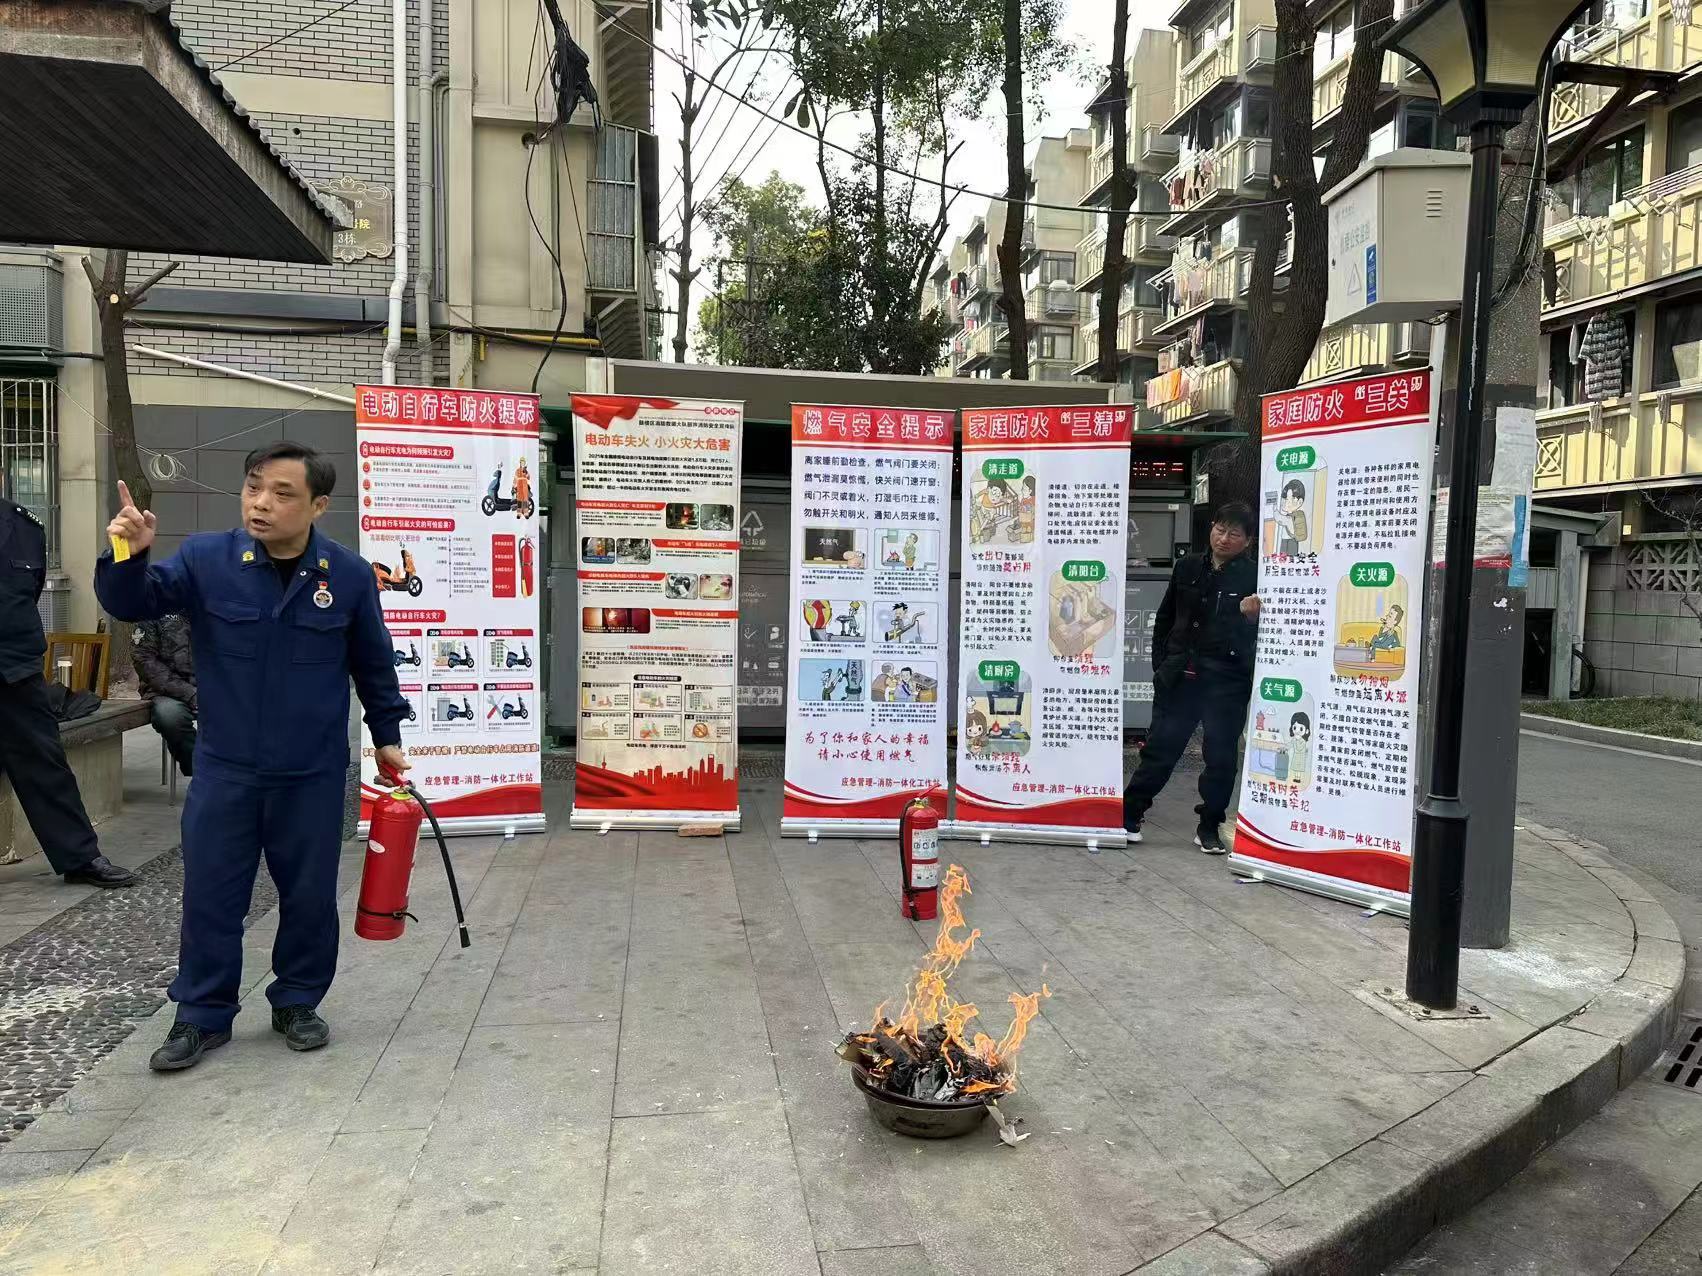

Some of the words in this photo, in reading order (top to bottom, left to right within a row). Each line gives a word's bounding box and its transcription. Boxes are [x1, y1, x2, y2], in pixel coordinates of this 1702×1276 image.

[338, 233, 356, 244] 3栋
[362, 391, 535, 425] 电动自行车防火提示
[1267, 389, 1344, 428] 家庭防火
[1355, 376, 1423, 413] “三关”
[803, 409, 944, 440] 燃气安全提示
[968, 412, 1049, 439] 家庭防火
[1060, 410, 1127, 437] “三清”
[585, 432, 650, 449] 电动车失火
[655, 436, 731, 452] 小火灾大危害
[1281, 451, 1309, 467] 关电源
[988, 463, 1018, 475] 清走道
[820, 538, 839, 546] 天然气
[1068, 565, 1099, 577] 清阳台
[1356, 568, 1388, 582] 关火源
[984, 664, 1014, 677] 清厨房
[1263, 681, 1296, 698] 关气源
[804, 731, 929, 745] 为了你和家人的幸福
[818, 747, 915, 762] 请小心使用燃气
[424, 773, 534, 786] 应急管理-消防一体化工作站
[1012, 782, 1116, 796] 应急管理-消防一体化工作站
[1290, 819, 1402, 852] 应急管理-消防一体化工作站
